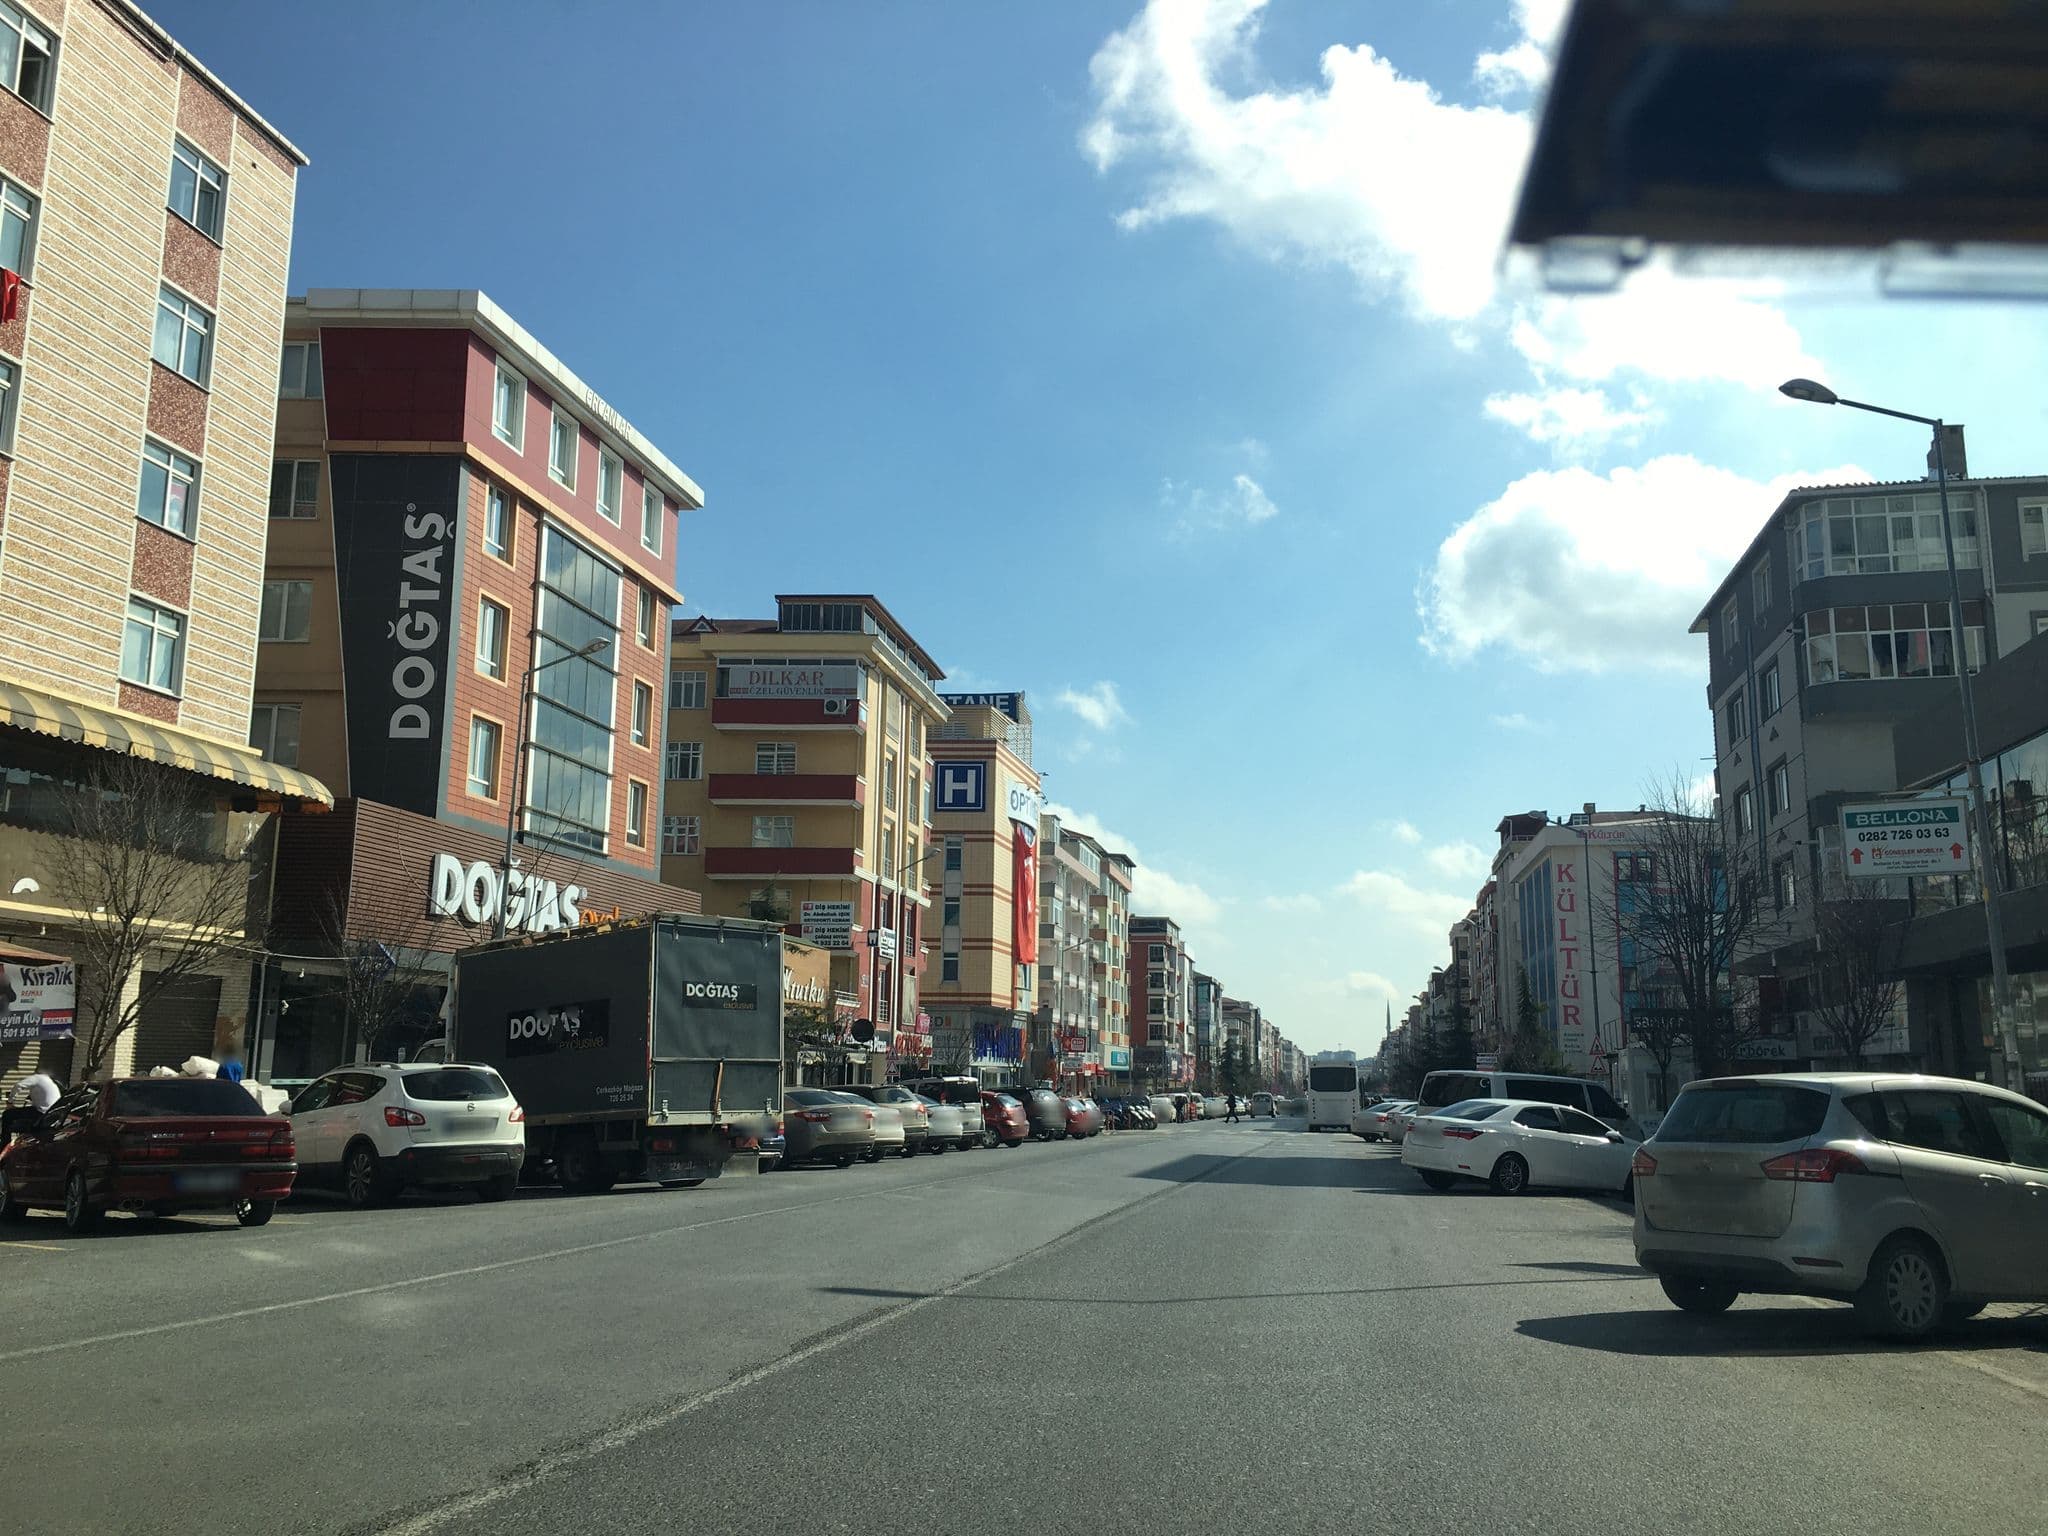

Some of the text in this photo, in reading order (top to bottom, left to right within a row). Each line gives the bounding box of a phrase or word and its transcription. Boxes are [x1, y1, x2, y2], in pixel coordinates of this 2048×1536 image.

[387, 511, 455, 739] DOĞTAŞ
[944, 769, 976, 804] H
[1855, 808, 1949, 826] BELLONA
[1858, 827, 1950, 842] 0282 726 03 63
[1556, 863, 1582, 1026] KÜLTÜR
[3, 1028, 18, 1038] 501
[19, 1027, 26, 1037] 9
[26, 1026, 39, 1037] 501
